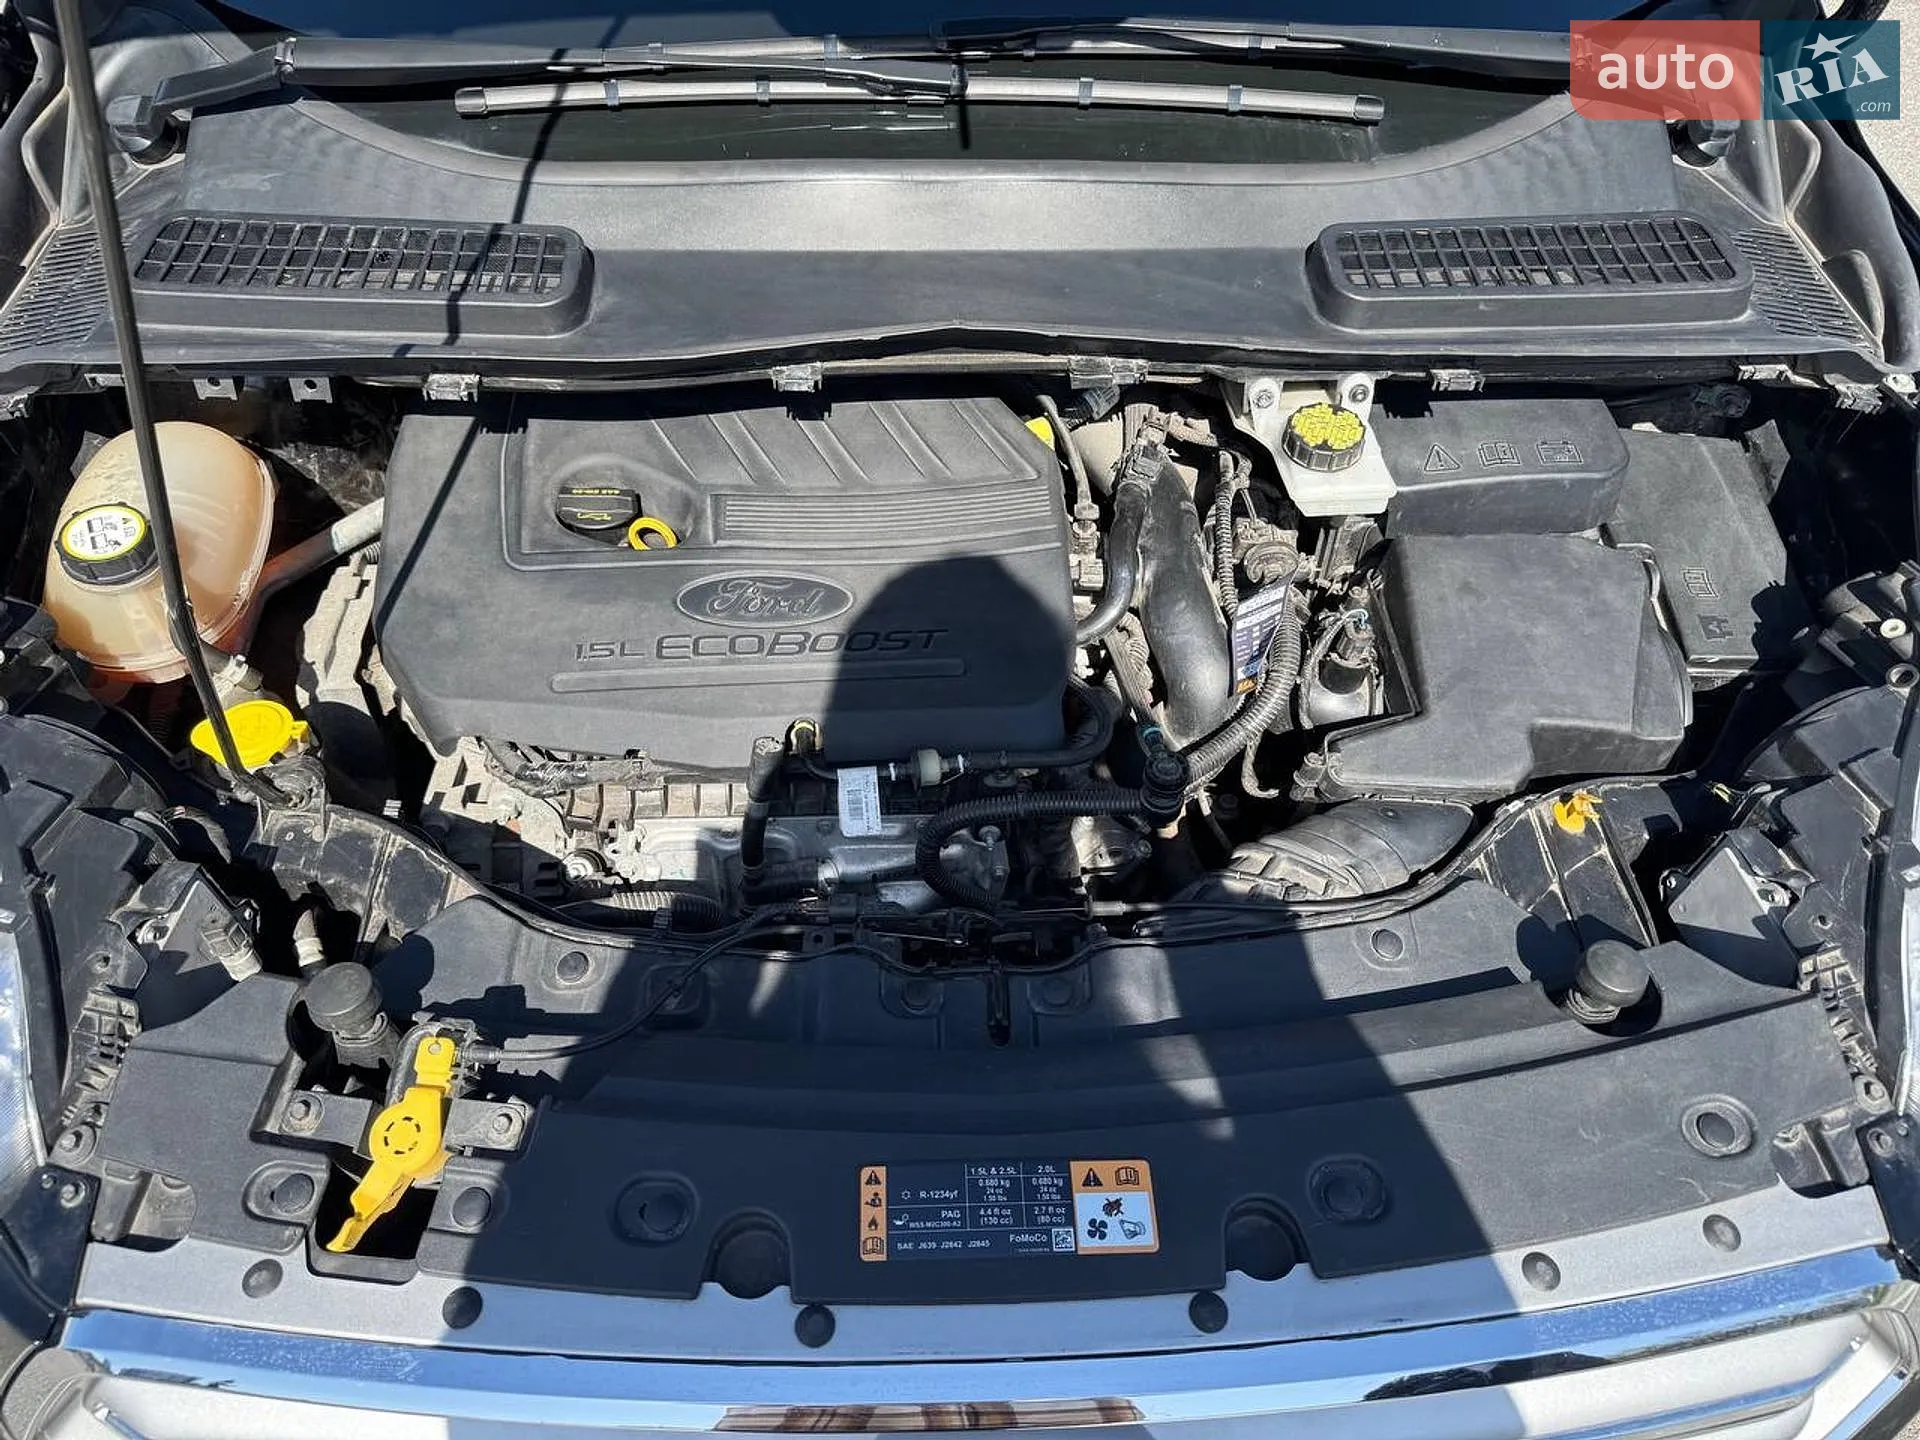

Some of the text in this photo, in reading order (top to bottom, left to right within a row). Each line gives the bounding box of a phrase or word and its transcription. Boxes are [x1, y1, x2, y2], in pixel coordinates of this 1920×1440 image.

[707, 583, 825, 616] Ford
[1038, 1165, 1056, 1173] 2.0L
[1000, 1178, 1010, 1188] kg
[1053, 1177, 1063, 1187] kg
[919, 1189, 959, 1200] R-1234yf
[941, 1210, 961, 1219] PAG
[1052, 1215, 1065, 1224] cc)
[1000, 1216, 1013, 1225] cc)
[1009, 1232, 1048, 1242] FoMoCo
